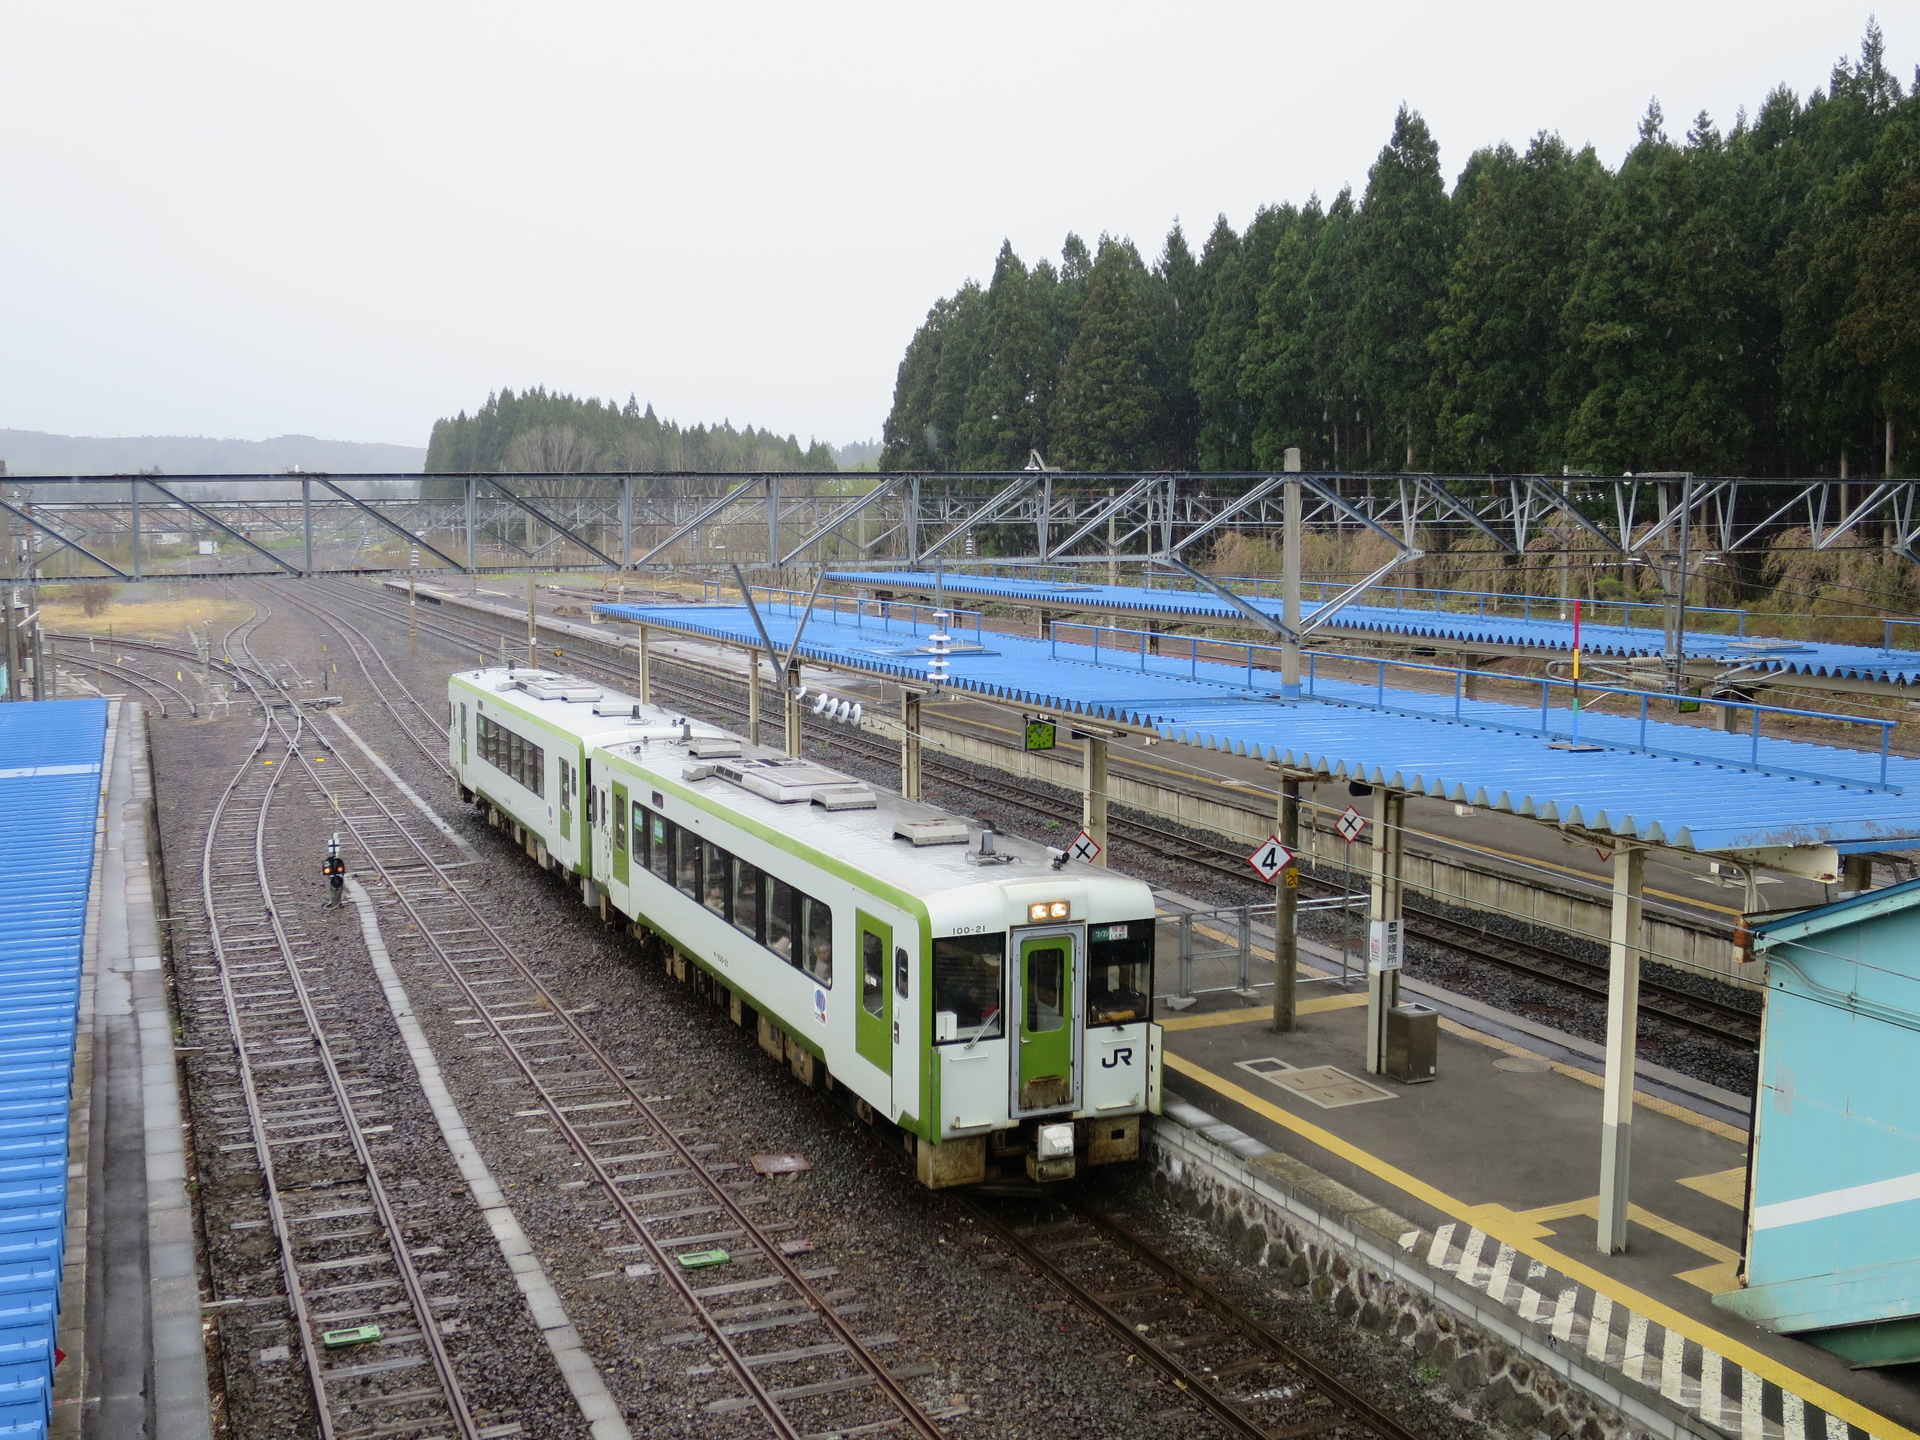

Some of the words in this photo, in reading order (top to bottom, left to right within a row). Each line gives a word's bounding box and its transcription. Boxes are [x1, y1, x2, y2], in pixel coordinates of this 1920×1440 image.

[1261, 847, 1278, 871] 4
[952, 925, 986, 935] 100-21
[1386, 934, 1398, 964] 喫煙所
[1101, 1047, 1133, 1069] JR
